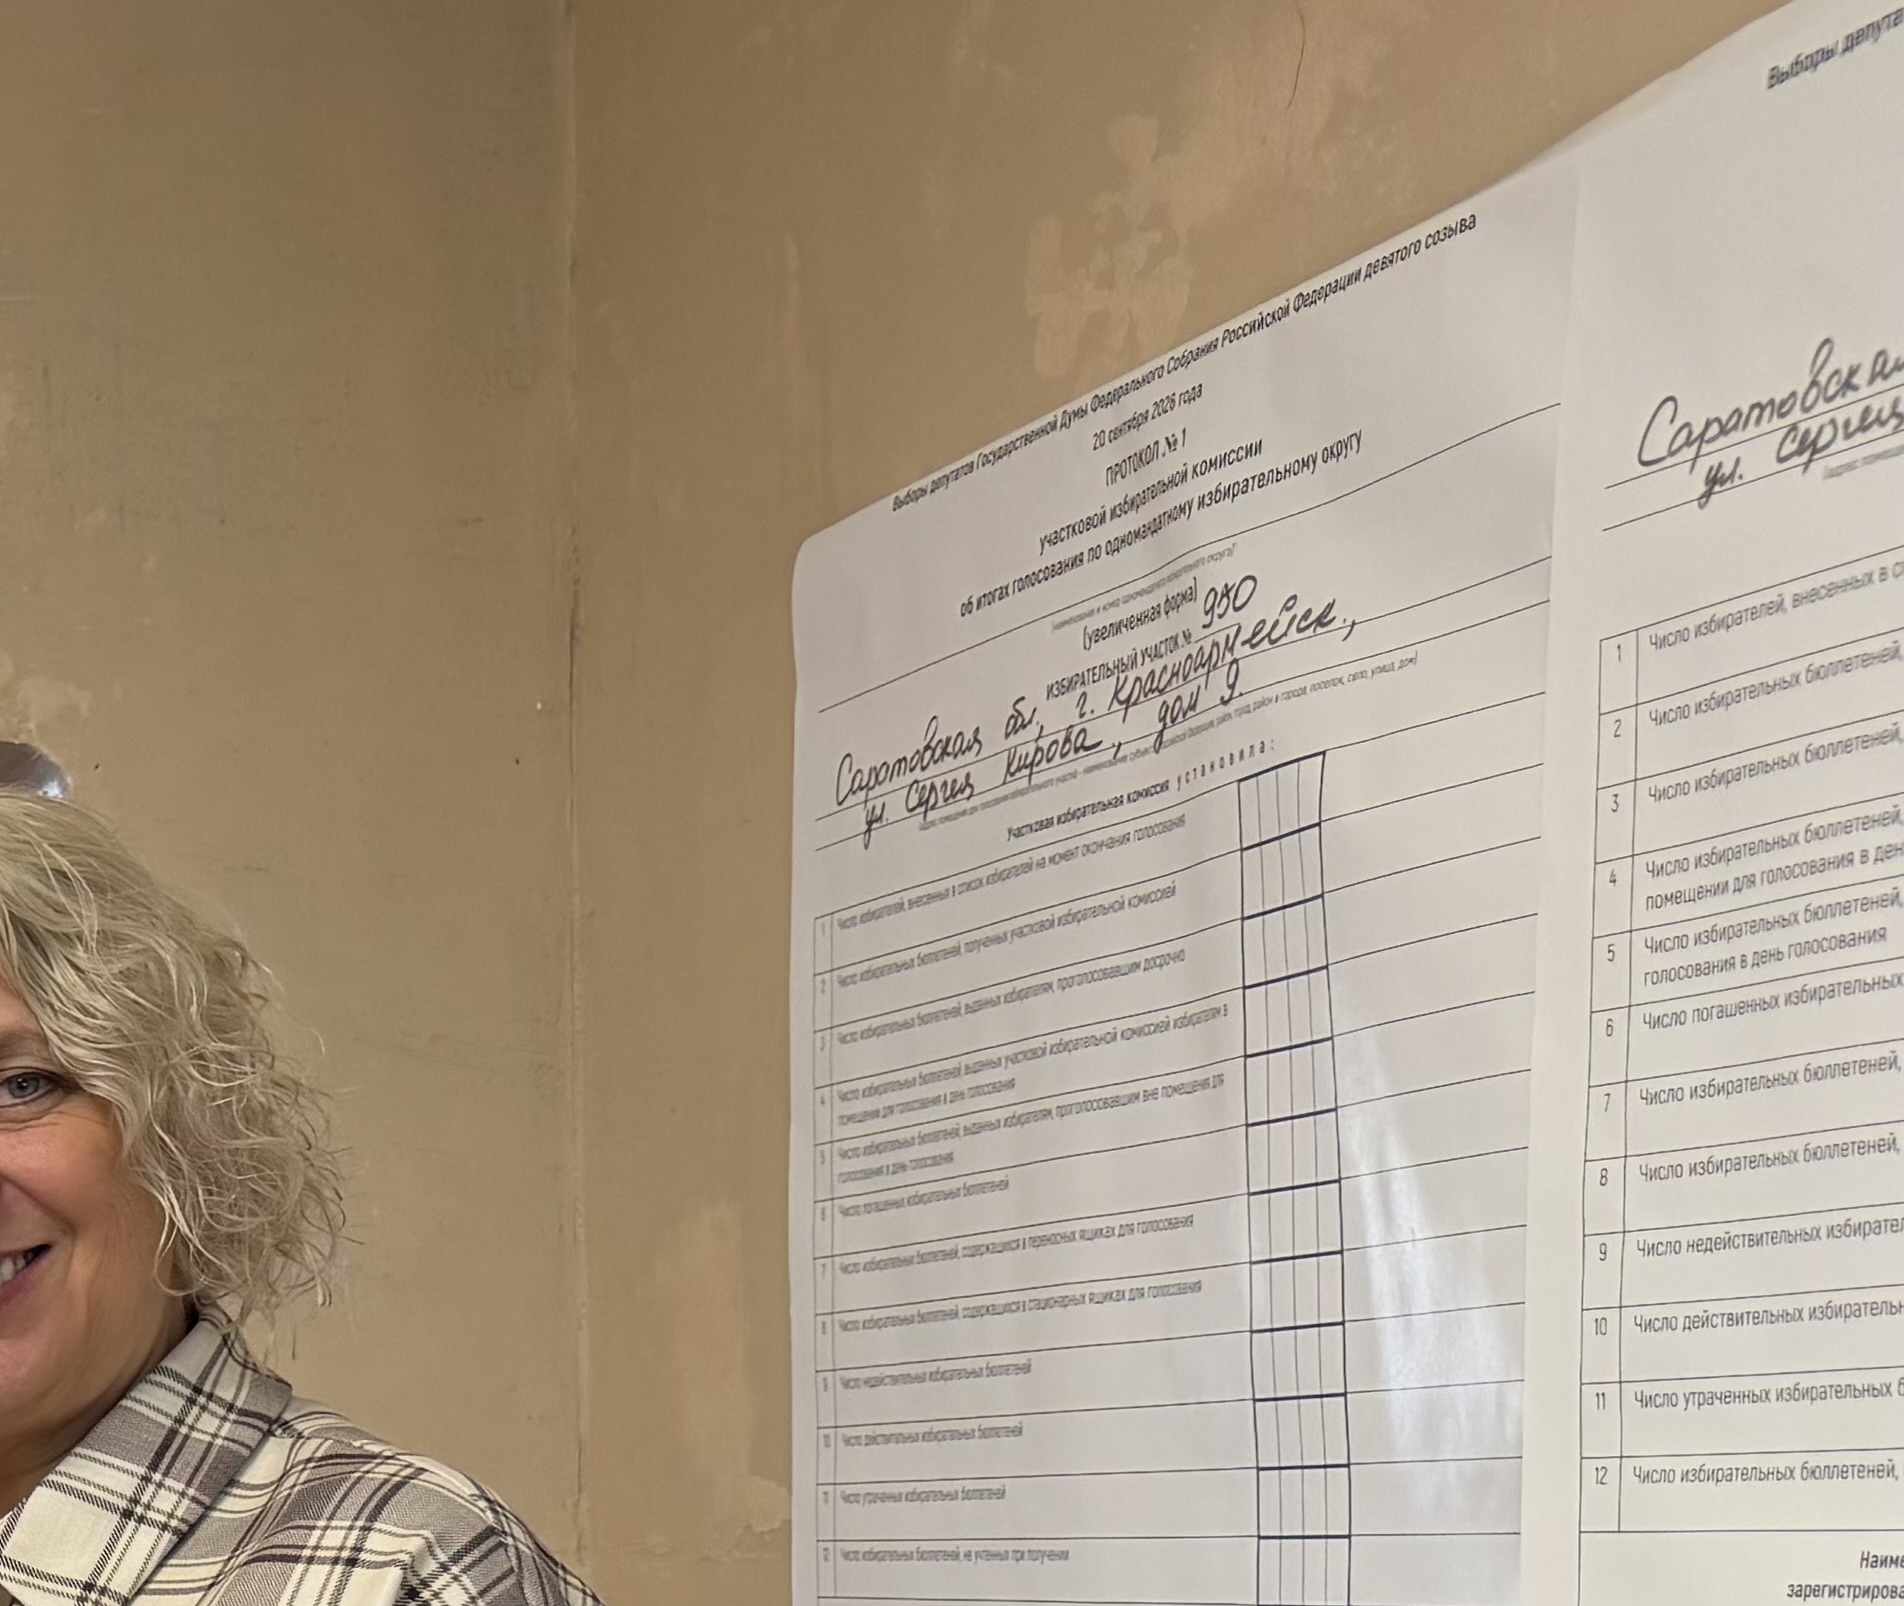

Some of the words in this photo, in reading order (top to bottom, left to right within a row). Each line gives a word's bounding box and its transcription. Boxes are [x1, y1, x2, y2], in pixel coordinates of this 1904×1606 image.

[1060, 403, 1088, 432] Думы
[1167, 338, 1218, 374] Собрания
[1221, 298, 1290, 348] Российской
[1293, 267, 1362, 313] Федерации
[1363, 239, 1421, 284] девятого
[1425, 214, 1476, 250] созыва
[1092, 430, 1105, 451] 20
[1178, 384, 1203, 407] года
[1106, 440, 1159, 489] ПРОТОКОЛ
[1182, 427, 1186, 448] 1
[960, 595, 973, 617] об
[975, 583, 1009, 611] итогах
[1012, 551, 1084, 595] голосования
[1087, 544, 1102, 563] по
[1105, 497, 1194, 557] одномандатному
[1197, 451, 1318, 510] избирательному
[1322, 428, 1362, 464] округу
[1039, 505, 1106, 556] участковой
[1110, 463, 1188, 522] избирательной
[1191, 439, 1262, 480] комиссии
[1082, 600, 1161, 652] (увеличенная
[1164, 577, 1197, 619] форма)
[1202, 575, 1257, 629] 950
[1047, 648, 1138, 701] ИЗБИРАТЕЛЬНЫЙ
[1141, 637, 1179, 668] УЧАСТОК
[837, 716, 982, 809] Саратовская
[906, 772, 974, 822] Сергея
[1154, 685, 1200, 754] дом
[1007, 816, 1054, 841] Участковая
[1056, 795, 1124, 825] избирательная
[1127, 780, 1169, 805] комиссия
[1607, 945, 1615, 961] 5
[1645, 931, 1690, 955] Число
[1693, 907, 1800, 948] избирательных
[1804, 887, 1903, 927] бюллетеней,
[1643, 951, 1736, 988] голосования
[1741, 954, 1747, 969] в
[1751, 946, 1784, 969] день
[1788, 925, 1887, 960] голосования
[1593, 1318, 1608, 1336] 10
[1633, 1312, 1678, 1334] Число
[1682, 1300, 1804, 1334] действительных
[1596, 1392, 1606, 1410] 11
[1634, 1387, 1679, 1410] Число
[1683, 1386, 1771, 1413] утраченных
[1775, 1375, 1893, 1404] избирательных
[1595, 1467, 1608, 1485] 12
[1633, 1464, 1676, 1485] Число
[1680, 1458, 1795, 1486] избирательных
[1800, 1456, 1899, 1482] бюллетеней,
